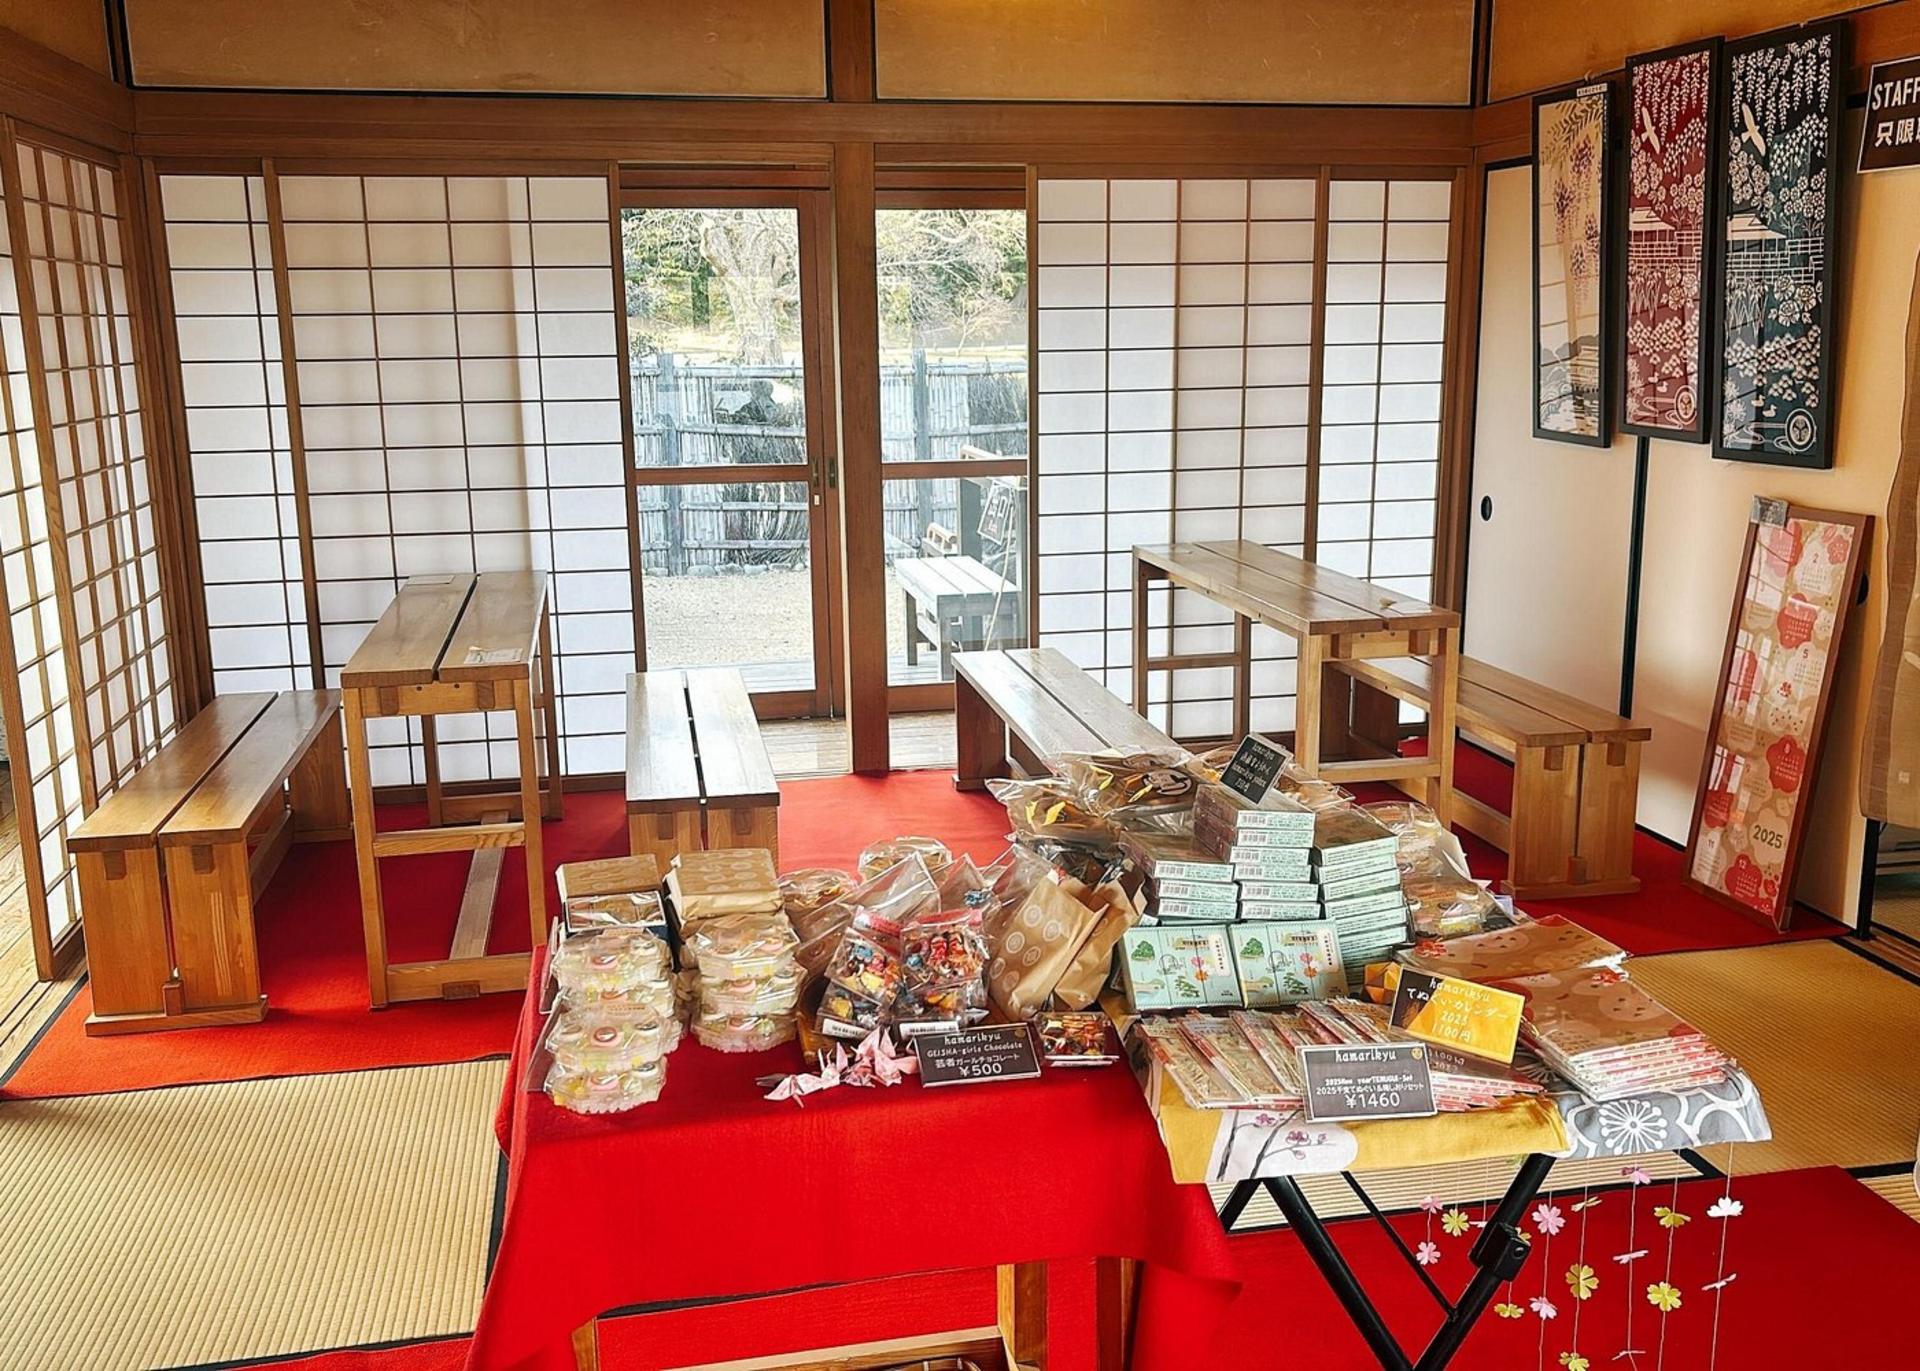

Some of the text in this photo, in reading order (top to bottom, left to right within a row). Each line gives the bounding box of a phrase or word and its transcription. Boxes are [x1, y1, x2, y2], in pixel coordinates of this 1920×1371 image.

[1872, 77, 1920, 110] STAFF
[1875, 117, 1920, 147] 只限
[1812, 553, 1819, 563] 2
[1802, 648, 1809, 659] 5
[1753, 825, 1783, 849] 2025
[1429, 977, 1490, 1002] hamarikyu
[944, 1032, 1001, 1046] hamarikyu
[927, 1041, 1023, 1058] GEISHA-girls Chocolate
[1335, 1048, 1397, 1063] hamarikyu
[935, 1053, 1020, 1069] 芸者ガールチョコレート
[959, 1062, 1002, 1077] ¥500
[1345, 1092, 1400, 1109] ¥1460
